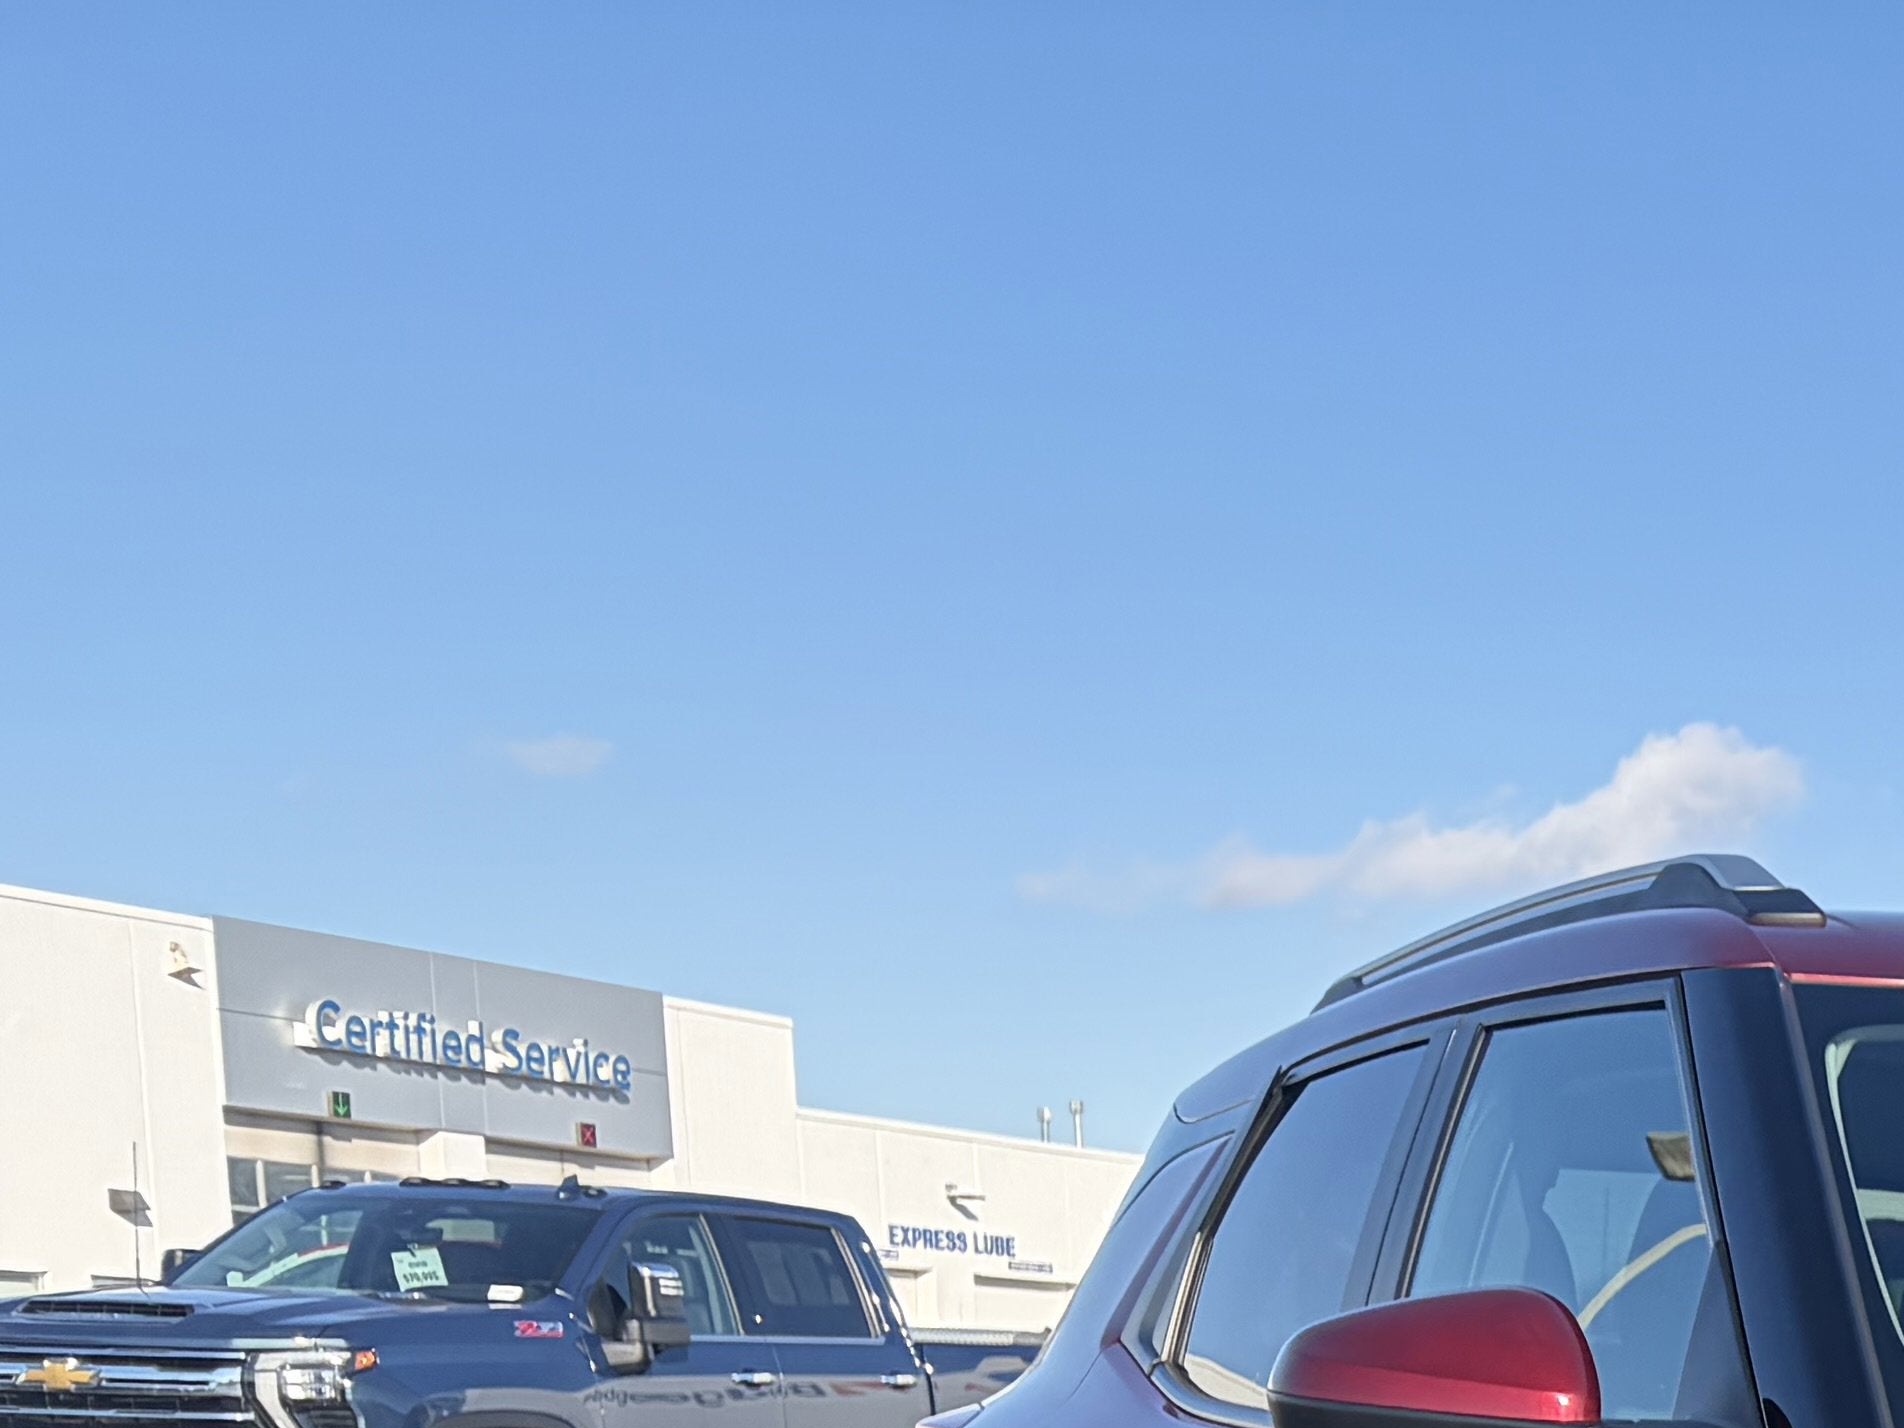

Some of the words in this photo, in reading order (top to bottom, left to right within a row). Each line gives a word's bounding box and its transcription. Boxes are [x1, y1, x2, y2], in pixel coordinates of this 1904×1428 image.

[314, 999, 486, 1068] Certified
[501, 1027, 632, 1090] Service
[888, 1224, 968, 1254] EXPRESS
[972, 1231, 1017, 1258] LUBE
